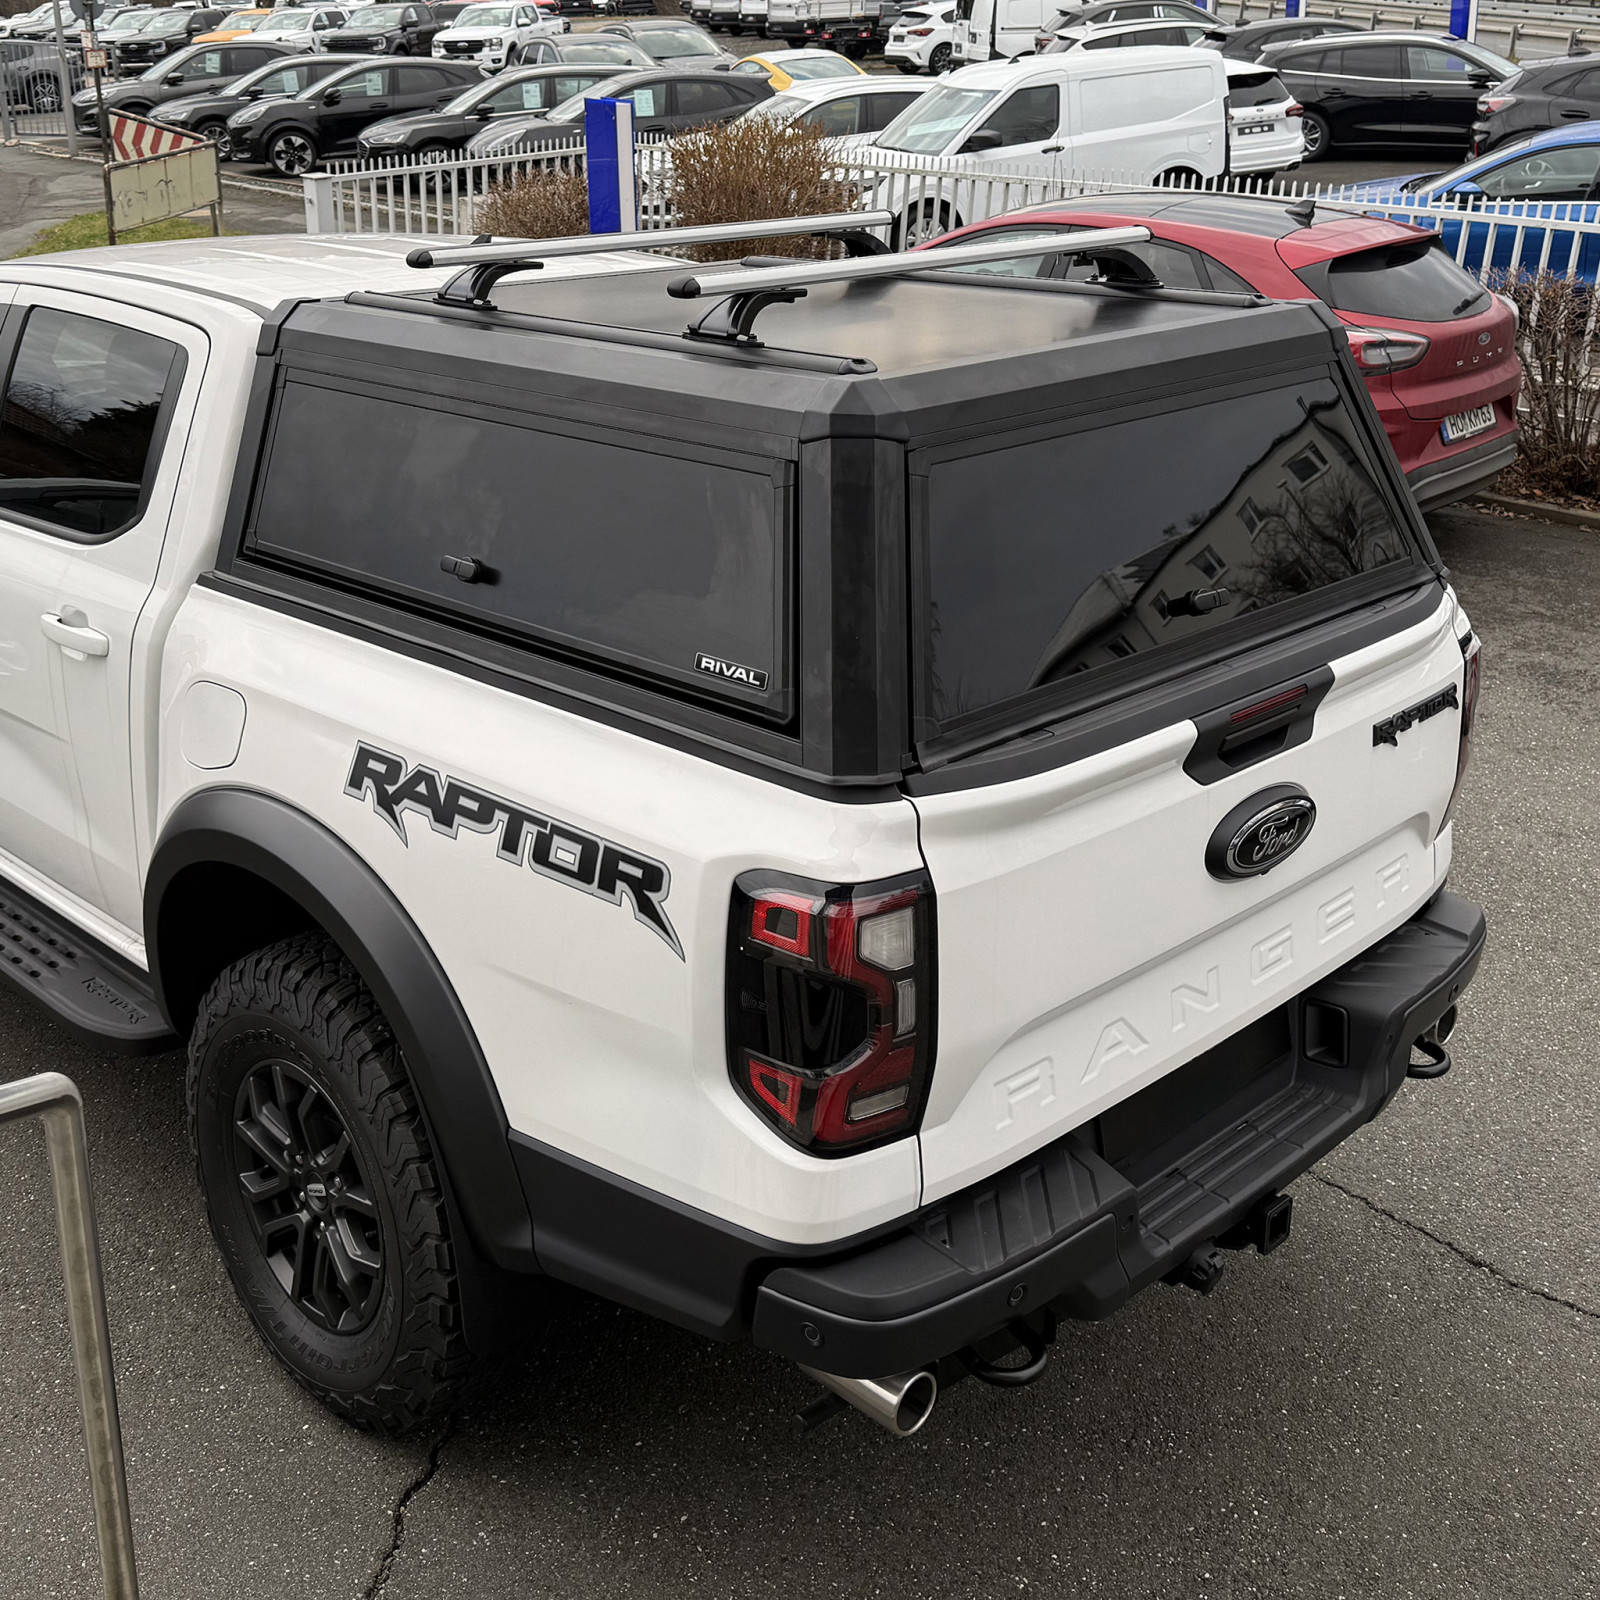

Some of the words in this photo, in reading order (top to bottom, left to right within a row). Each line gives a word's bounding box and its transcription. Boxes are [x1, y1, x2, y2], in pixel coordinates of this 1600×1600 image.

[700, 657, 760, 685] RIVAL
[1372, 681, 1459, 747] RAPTOR
[343, 740, 686, 963] RAPTOR
[1252, 815, 1300, 861] Ford
[993, 852, 1410, 1131] RANGER
